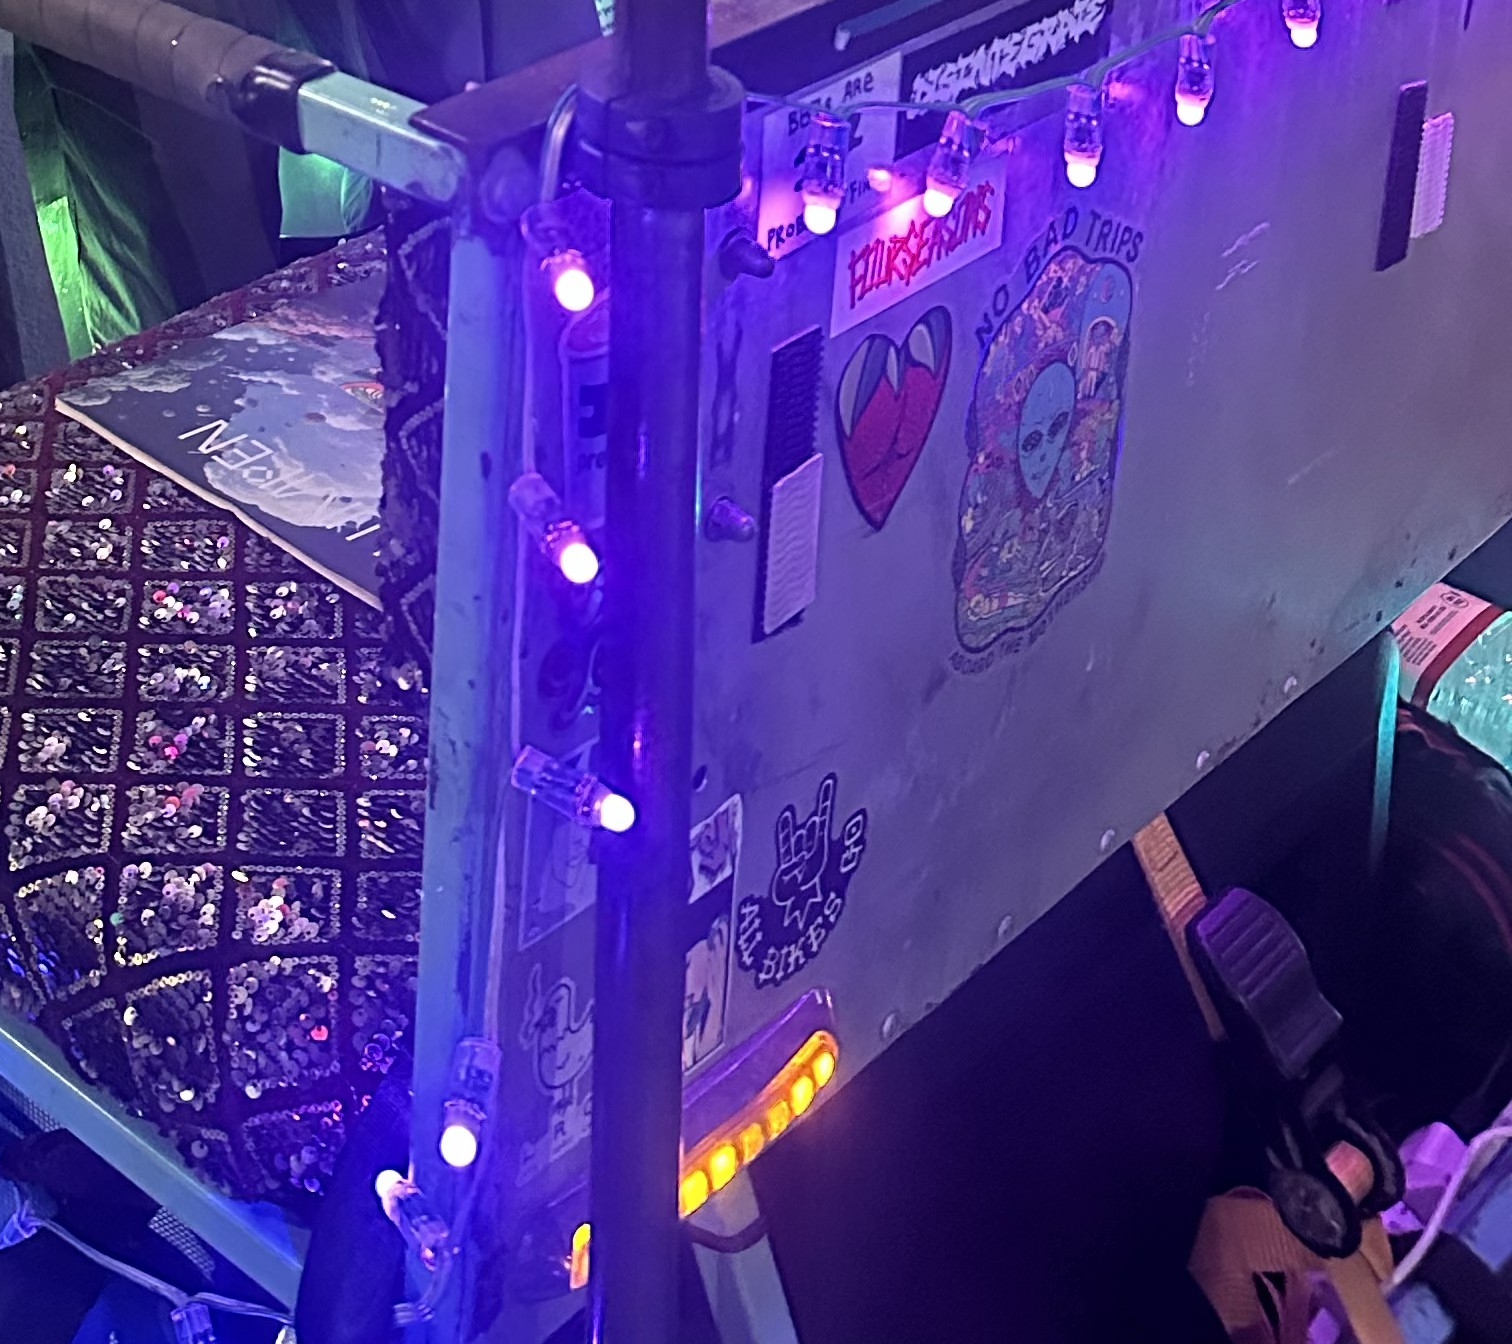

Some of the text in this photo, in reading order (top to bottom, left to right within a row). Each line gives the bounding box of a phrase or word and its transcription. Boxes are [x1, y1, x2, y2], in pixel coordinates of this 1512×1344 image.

[1024, 206, 1078, 283] BAD
[1085, 210, 1143, 262] TRIPS
[738, 814, 864, 983] ALL BIKES GO
